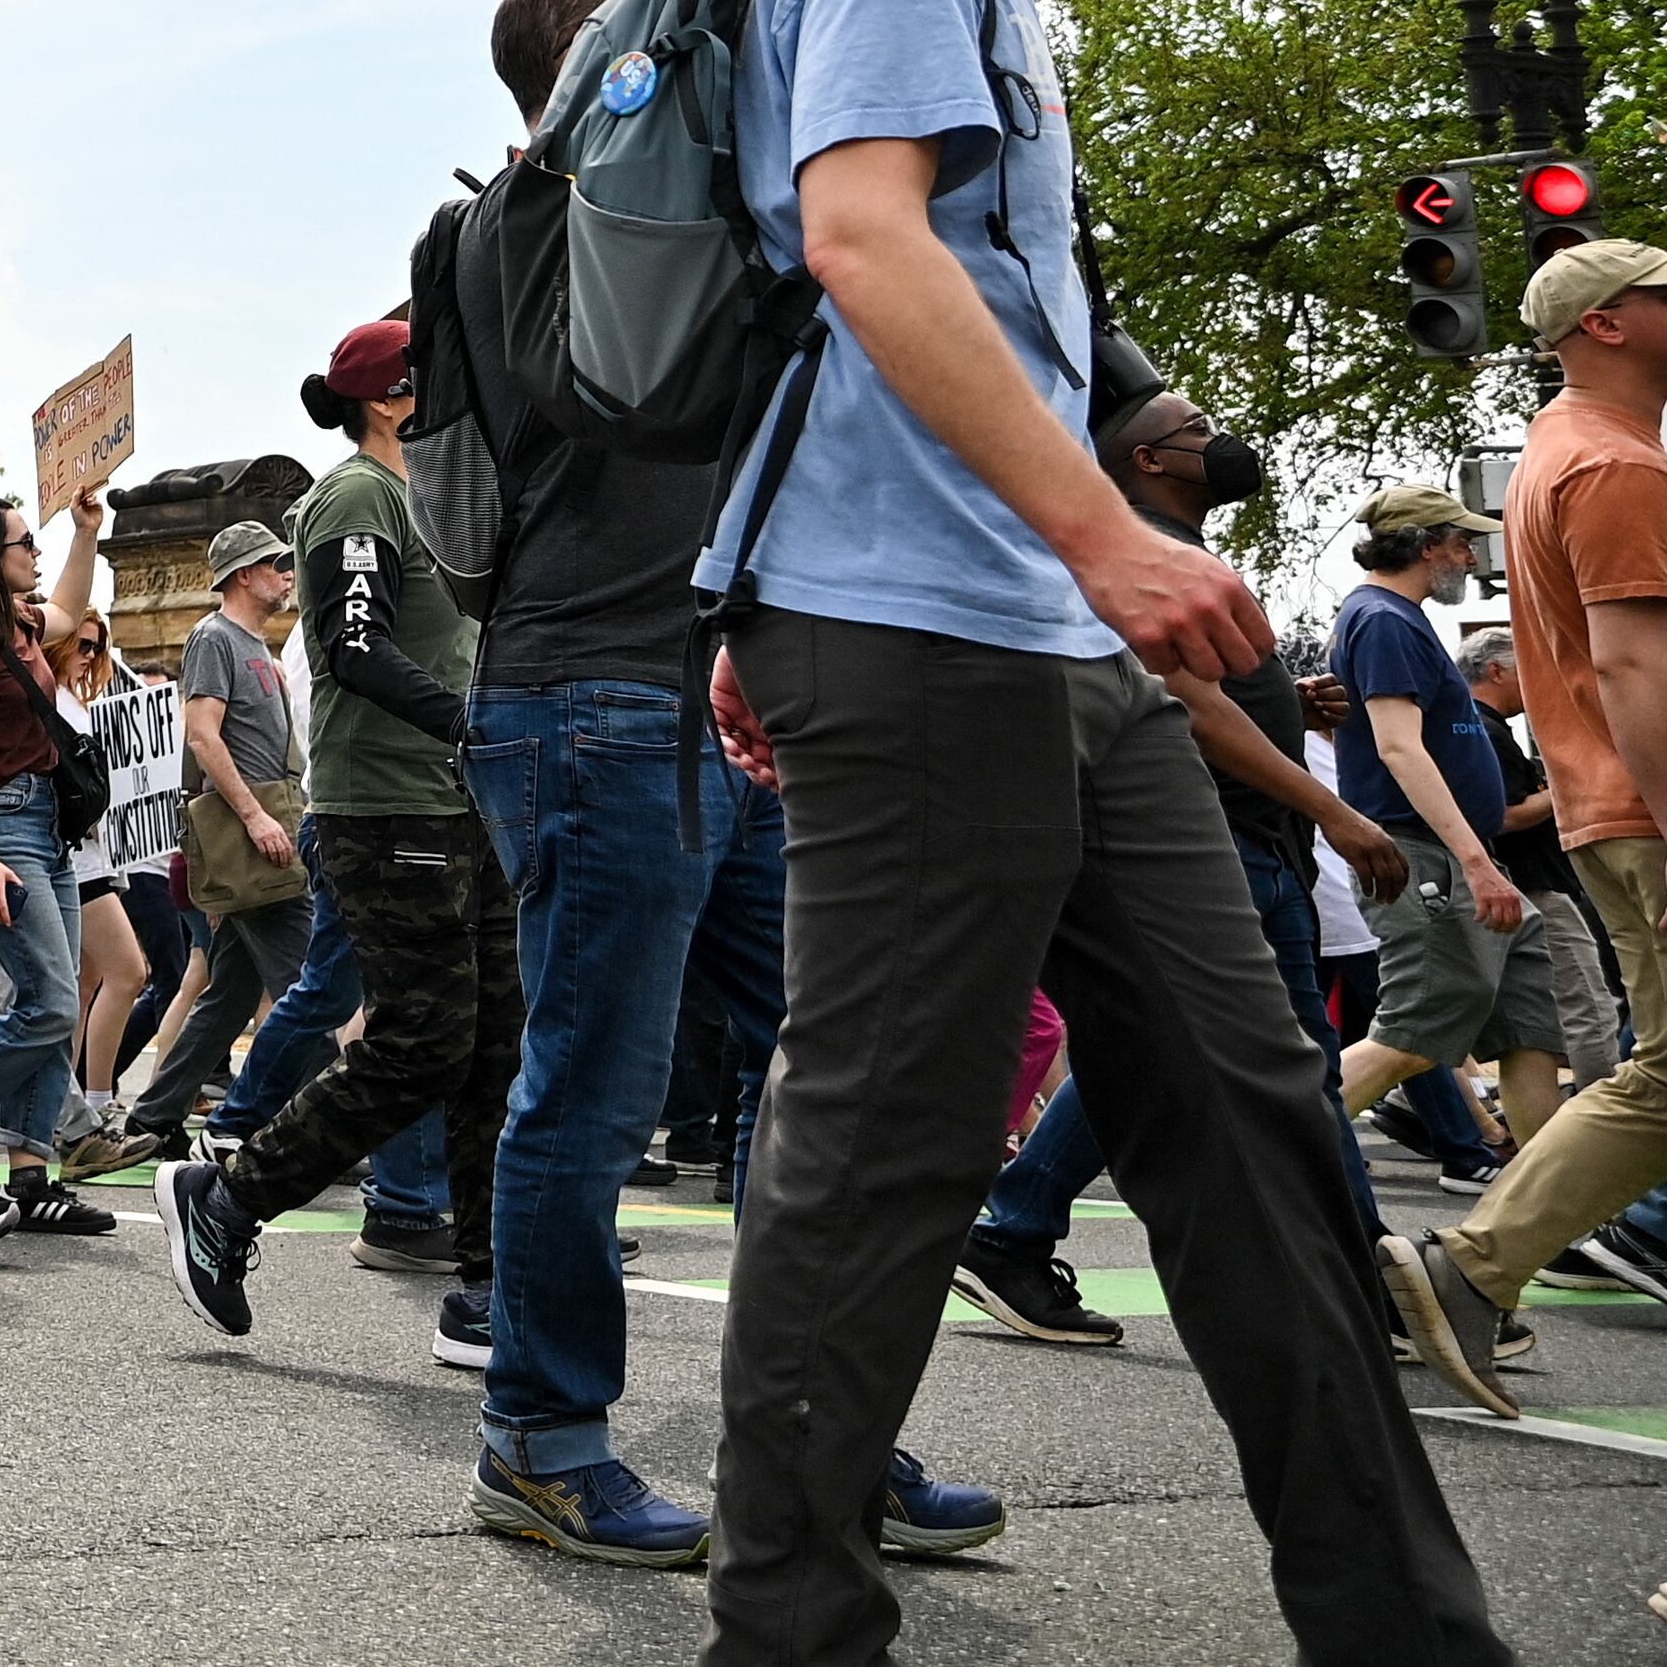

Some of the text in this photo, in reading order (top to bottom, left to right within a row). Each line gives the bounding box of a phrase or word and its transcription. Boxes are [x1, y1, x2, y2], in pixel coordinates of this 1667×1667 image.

[60, 397, 76, 425] OF
[76, 384, 100, 414] THE
[71, 450, 88, 482] IN
[91, 412, 131, 468] POWER
[90, 687, 174, 771] HANDS OFF
[132, 765, 150, 796] OUR
